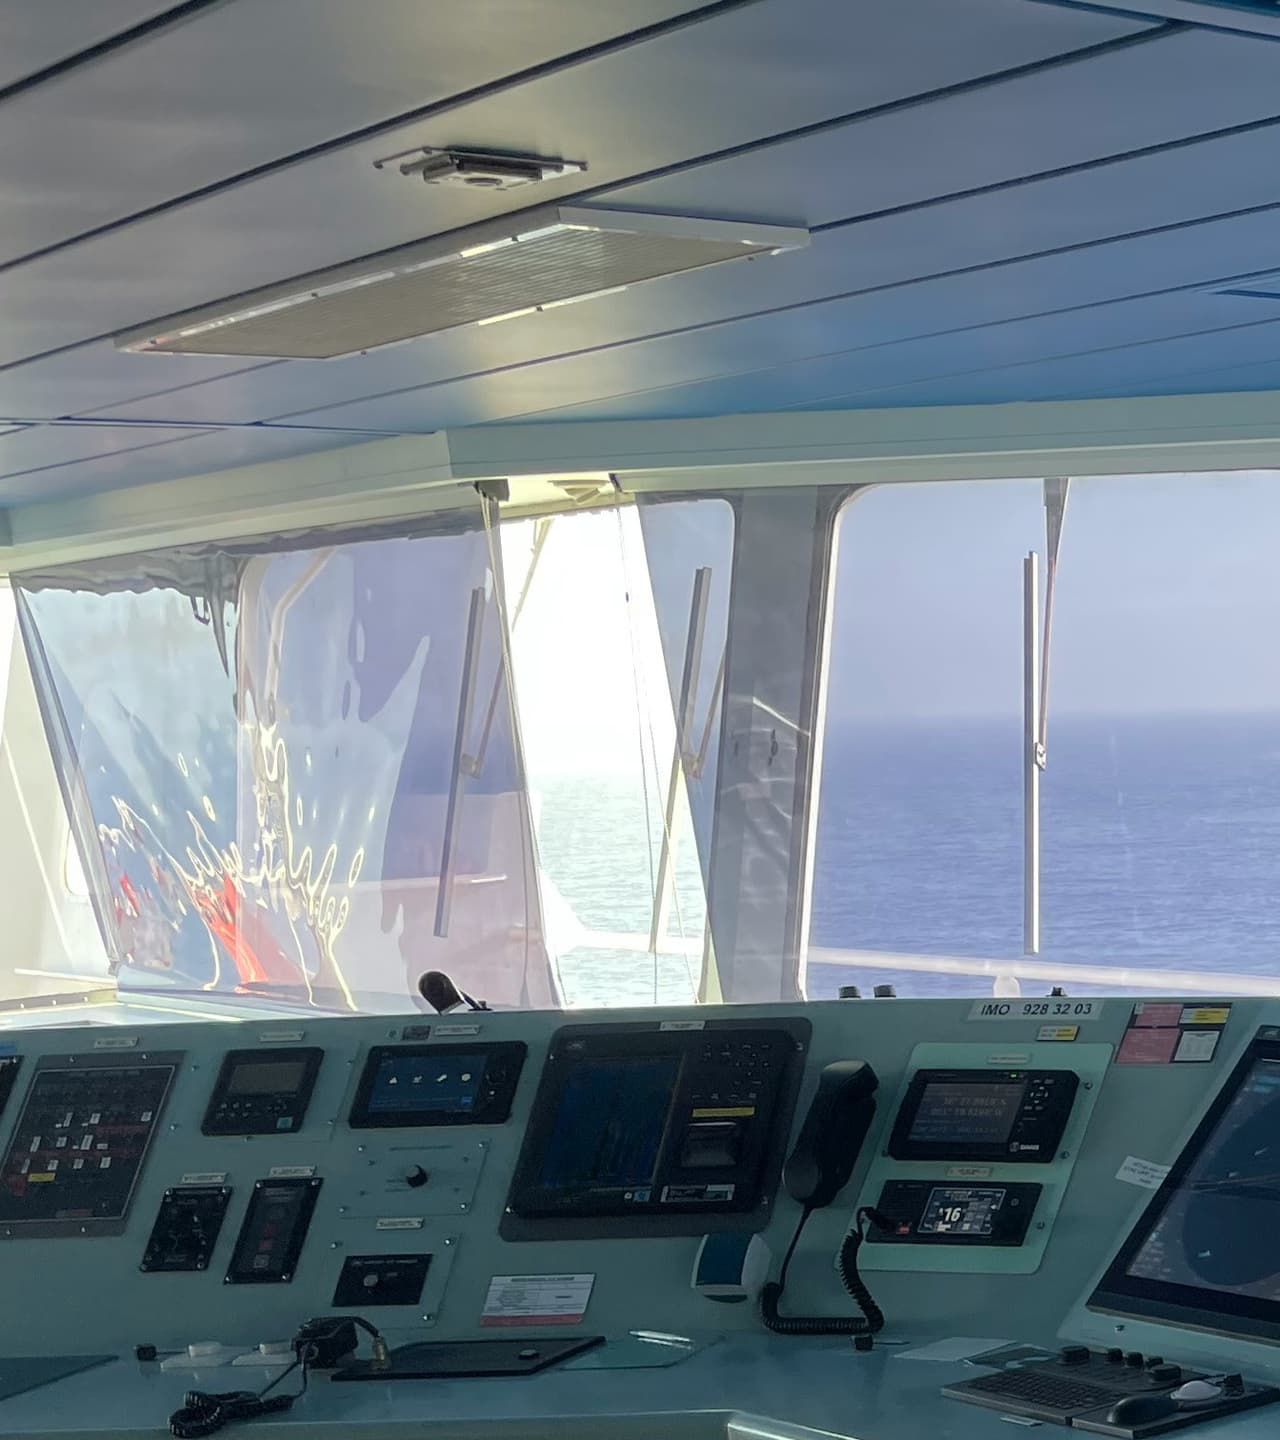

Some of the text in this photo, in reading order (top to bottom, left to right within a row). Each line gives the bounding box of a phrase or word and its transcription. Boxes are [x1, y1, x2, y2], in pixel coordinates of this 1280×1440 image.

[981, 1003, 1092, 1016] IMO 928 32 03
[943, 1207, 962, 1223] 16
